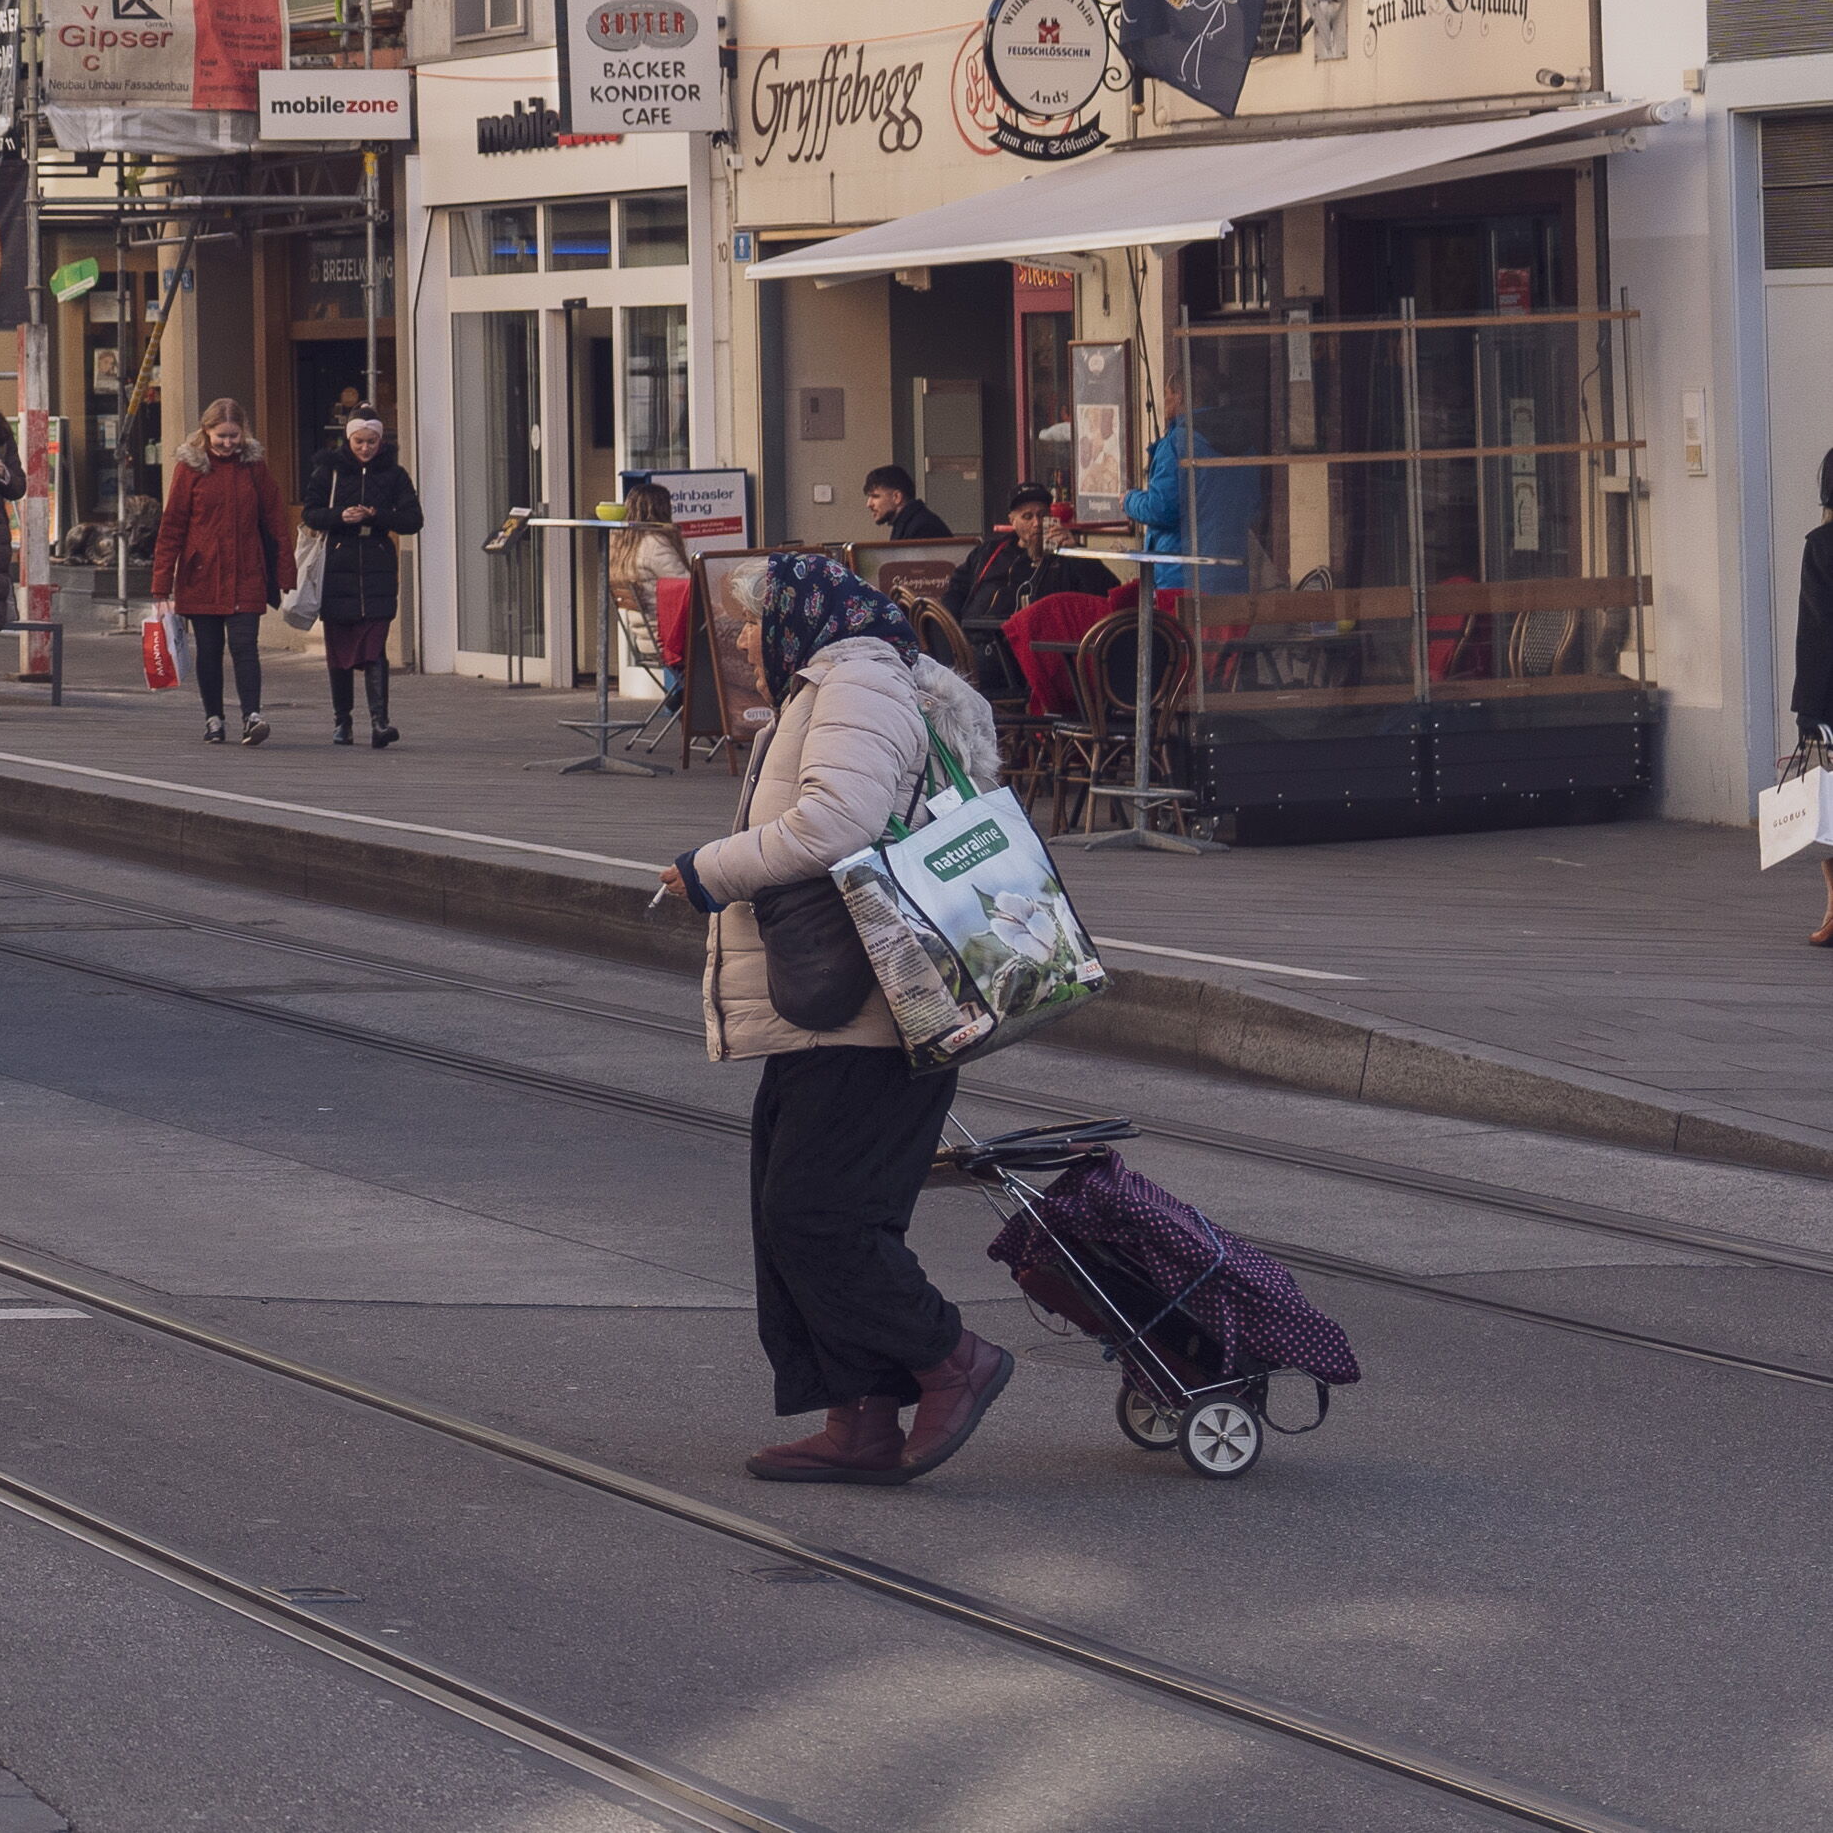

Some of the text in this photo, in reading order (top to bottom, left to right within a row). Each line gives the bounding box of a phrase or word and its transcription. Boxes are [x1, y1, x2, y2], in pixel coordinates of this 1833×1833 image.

[600, 11, 686, 35] SUTTER
[1077, 0, 1095, 27] bim
[58, 24, 174, 52] Gipser
[1007, 44, 1091, 58] FELDSCHLÖSSCHEN
[603, 58, 686, 80] BÄCKER
[48, 78, 86, 91] Neubau
[88, 79, 122, 91] Umbau
[124, 80, 190, 93] Fassadenbau
[590, 84, 701, 103] KONDITOR
[271, 96, 399, 114] mobilezone
[751, 43, 924, 168] Gryffebegg
[622, 108, 672, 126] CAFE
[322, 256, 393, 283] BREZELKNIG
[670, 488, 735, 502] einbasler
[671, 502, 712, 516] eitung
[1773, 807, 1807, 828] GLOBUS
[931, 823, 1003, 874] naturaline
[951, 1023, 981, 1046] coop
